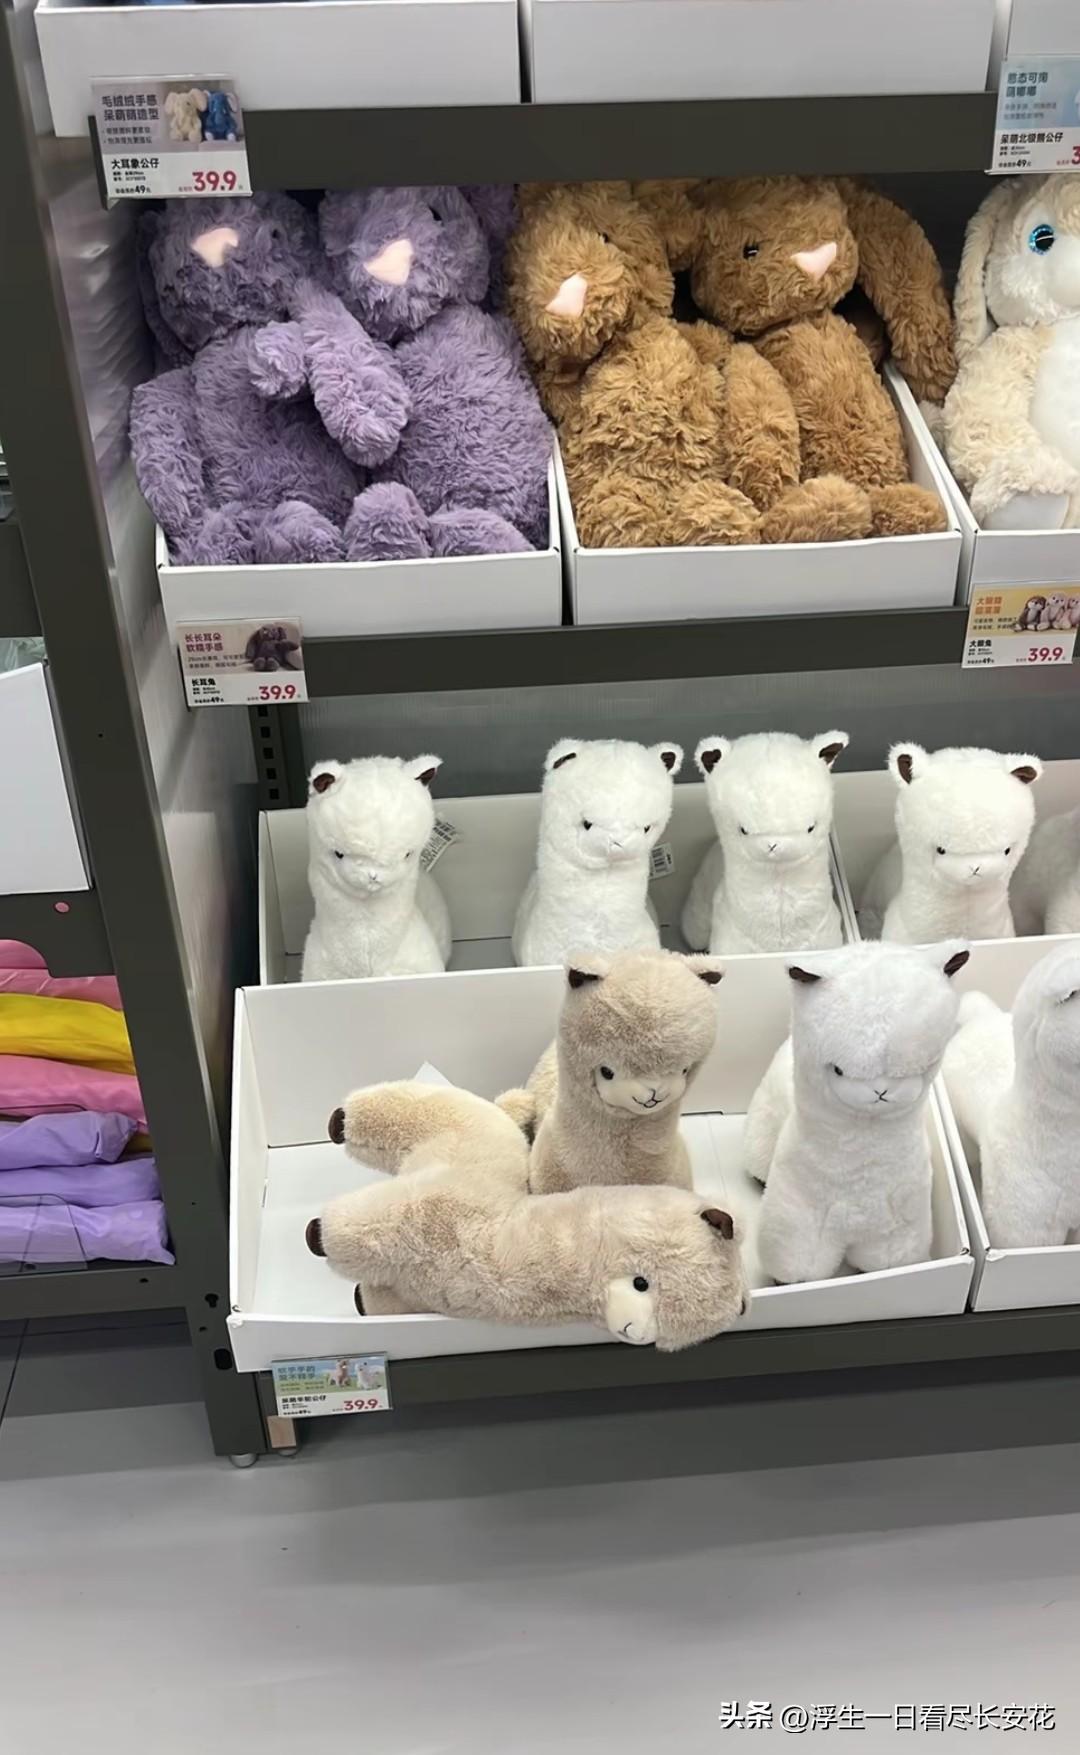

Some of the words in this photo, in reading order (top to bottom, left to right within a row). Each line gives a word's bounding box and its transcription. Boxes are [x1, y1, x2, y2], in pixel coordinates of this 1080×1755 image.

[102, 94, 158, 107] 毛绒绒手感
[104, 108, 160, 121] 呆萌萌造型
[111, 158, 159, 170] 大耳象公仔
[192, 170, 237, 192] 39.9
[185, 632, 222, 642] 长长耳朵
[969, 639, 993, 648] 大眼兔
[186, 643, 223, 652] 软糯手感
[1028, 647, 1063, 662] 39.9
[191, 678, 217, 687] 长耳兔
[258, 684, 296, 700] 39.9
[343, 1398, 379, 1412] 39.9
